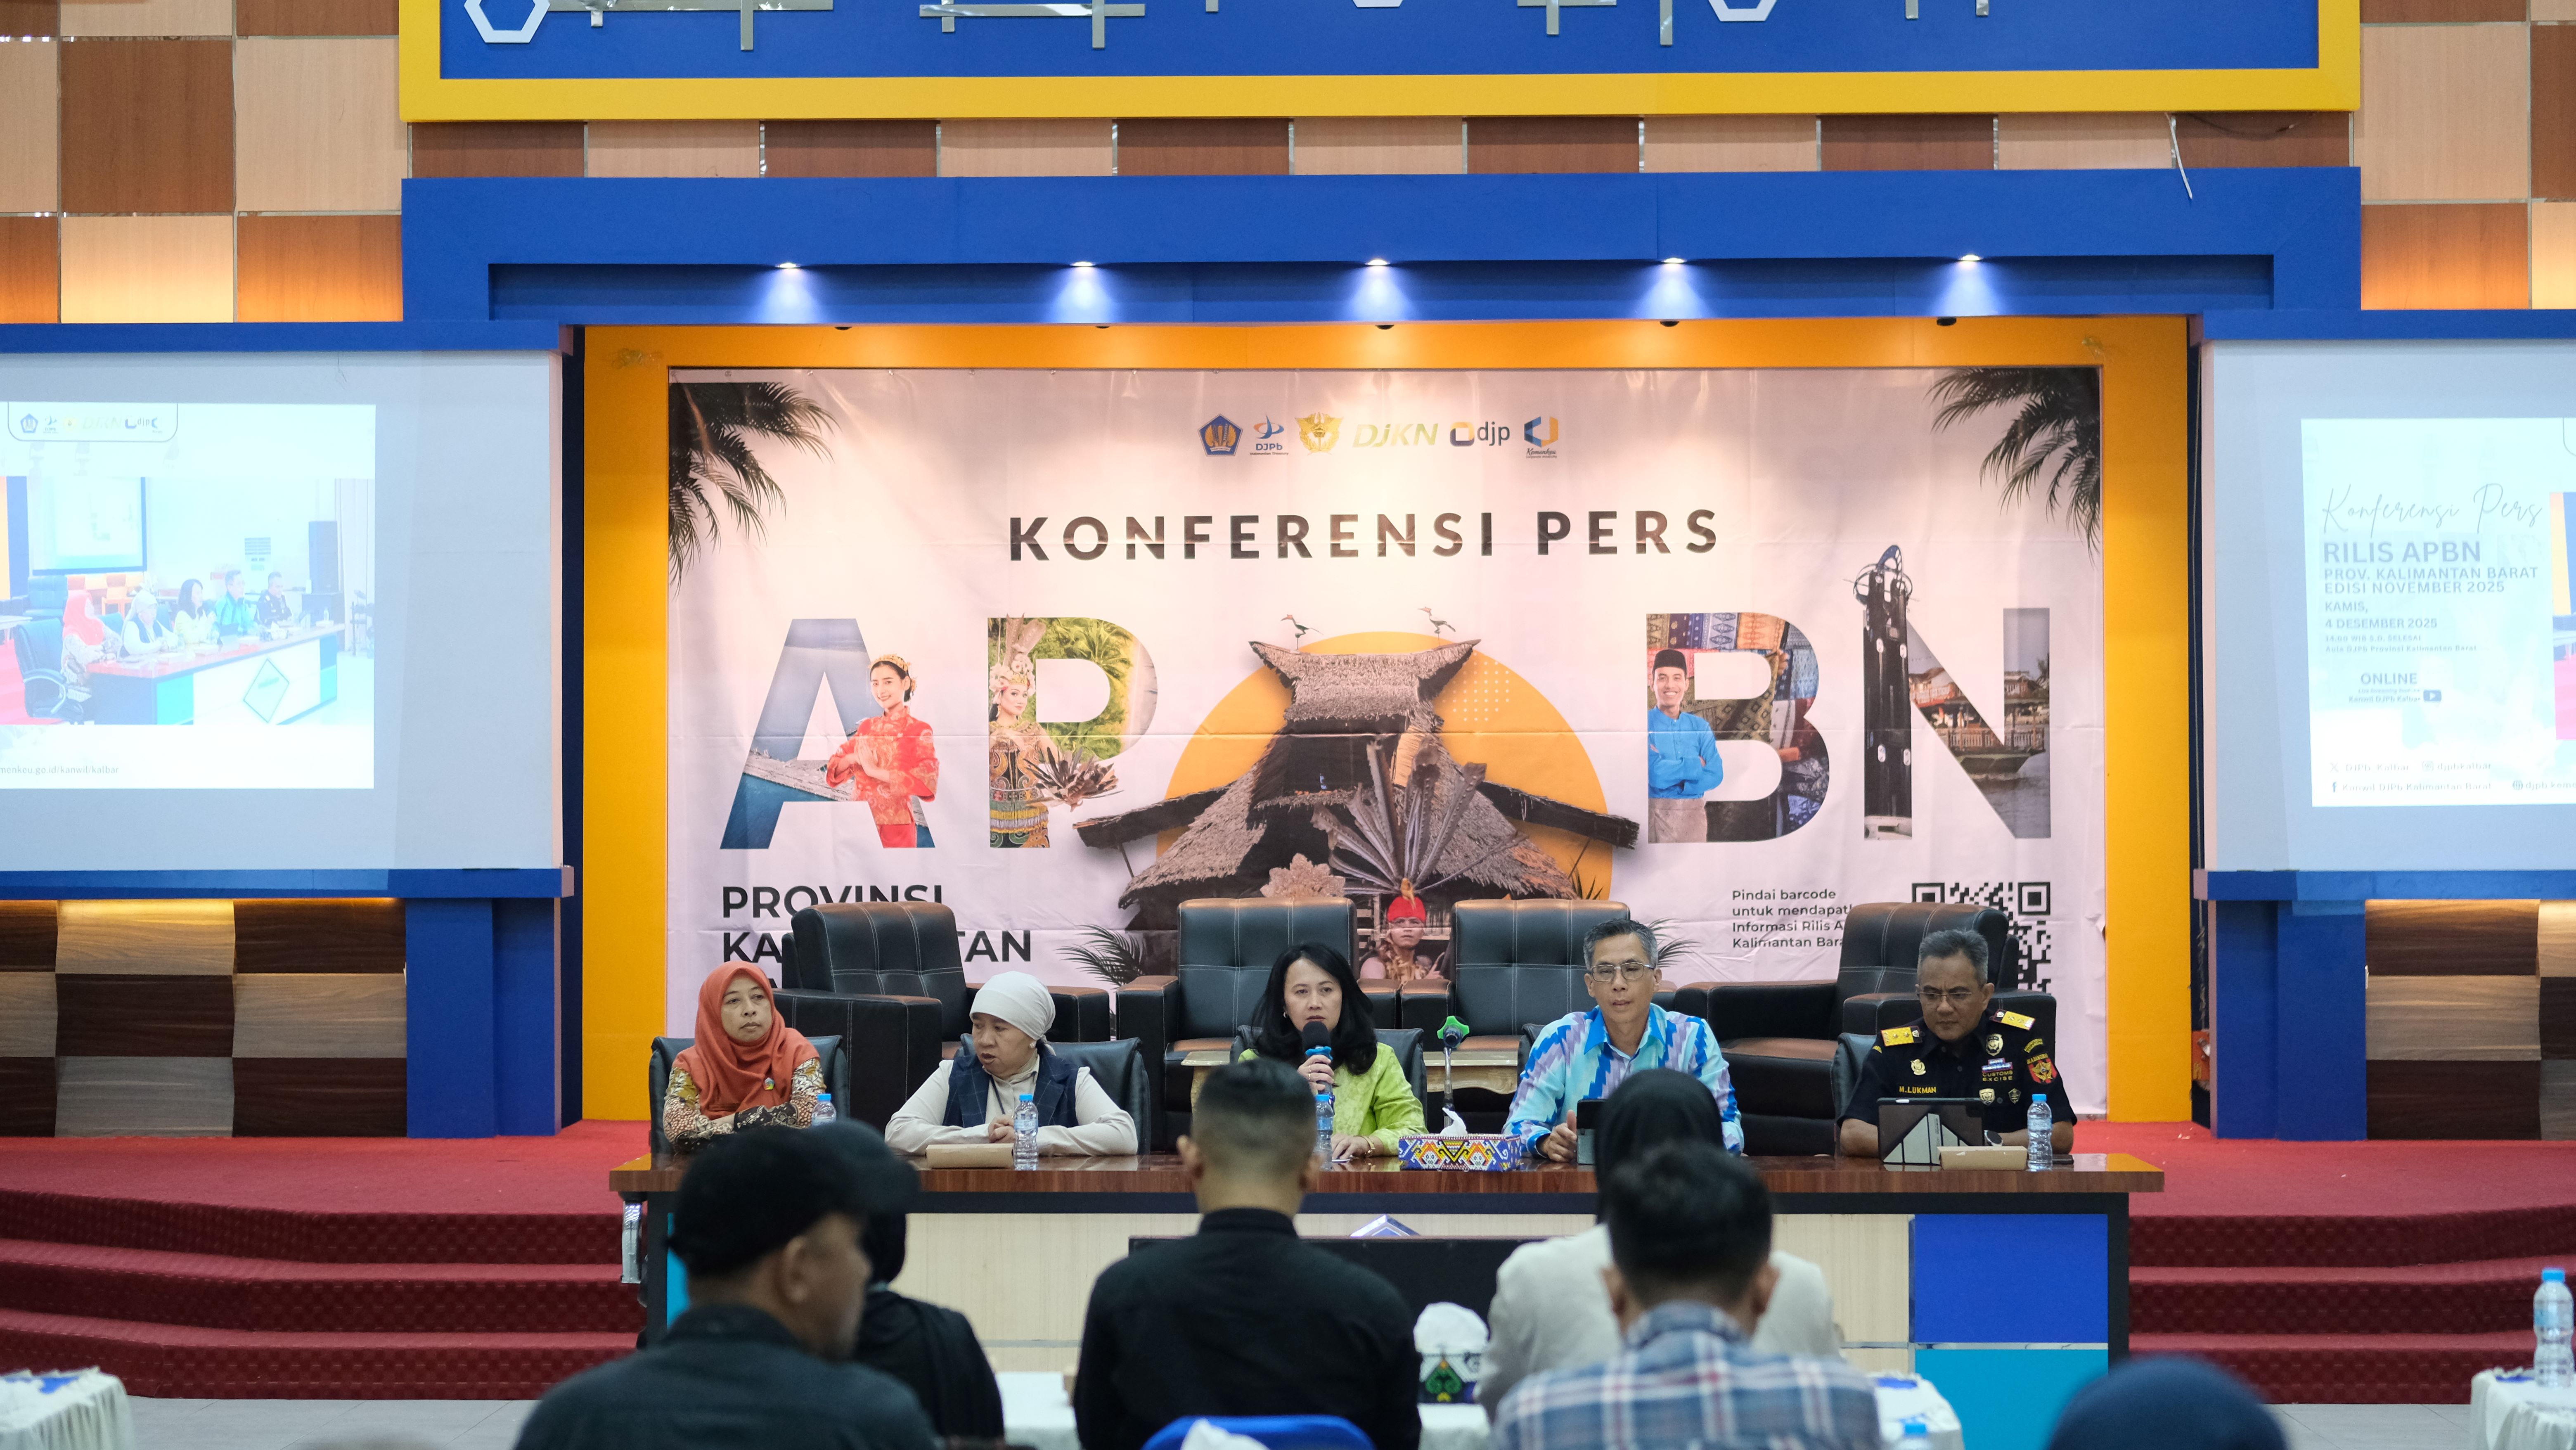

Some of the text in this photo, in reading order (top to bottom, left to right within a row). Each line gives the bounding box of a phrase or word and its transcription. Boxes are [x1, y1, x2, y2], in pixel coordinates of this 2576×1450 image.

[1477, 422, 1510, 446] djp
[2322, 483, 2542, 538] Konferensi Pers
[1010, 509, 1717, 561] KONFERENSI PERS
[2324, 541, 2480, 562] RILIS APBN
[2325, 567, 2538, 580] PROV. KALIMANTAN BARAT
[2325, 581, 2504, 594] EDISI NOVEMBER 2025
[2325, 601, 2368, 613] KAMIS,
[2325, 618, 2438, 628] 4 DESEMBER 2025
[2361, 673, 2417, 684] ONLINE
[1732, 888, 1836, 900] Pindai barcode
[1732, 904, 1852, 917] untuk mendapat
[1733, 920, 1797, 932] Informasi
[1802, 920, 1830, 931] Rilis
[1733, 937, 1811, 948] Kalimantan
